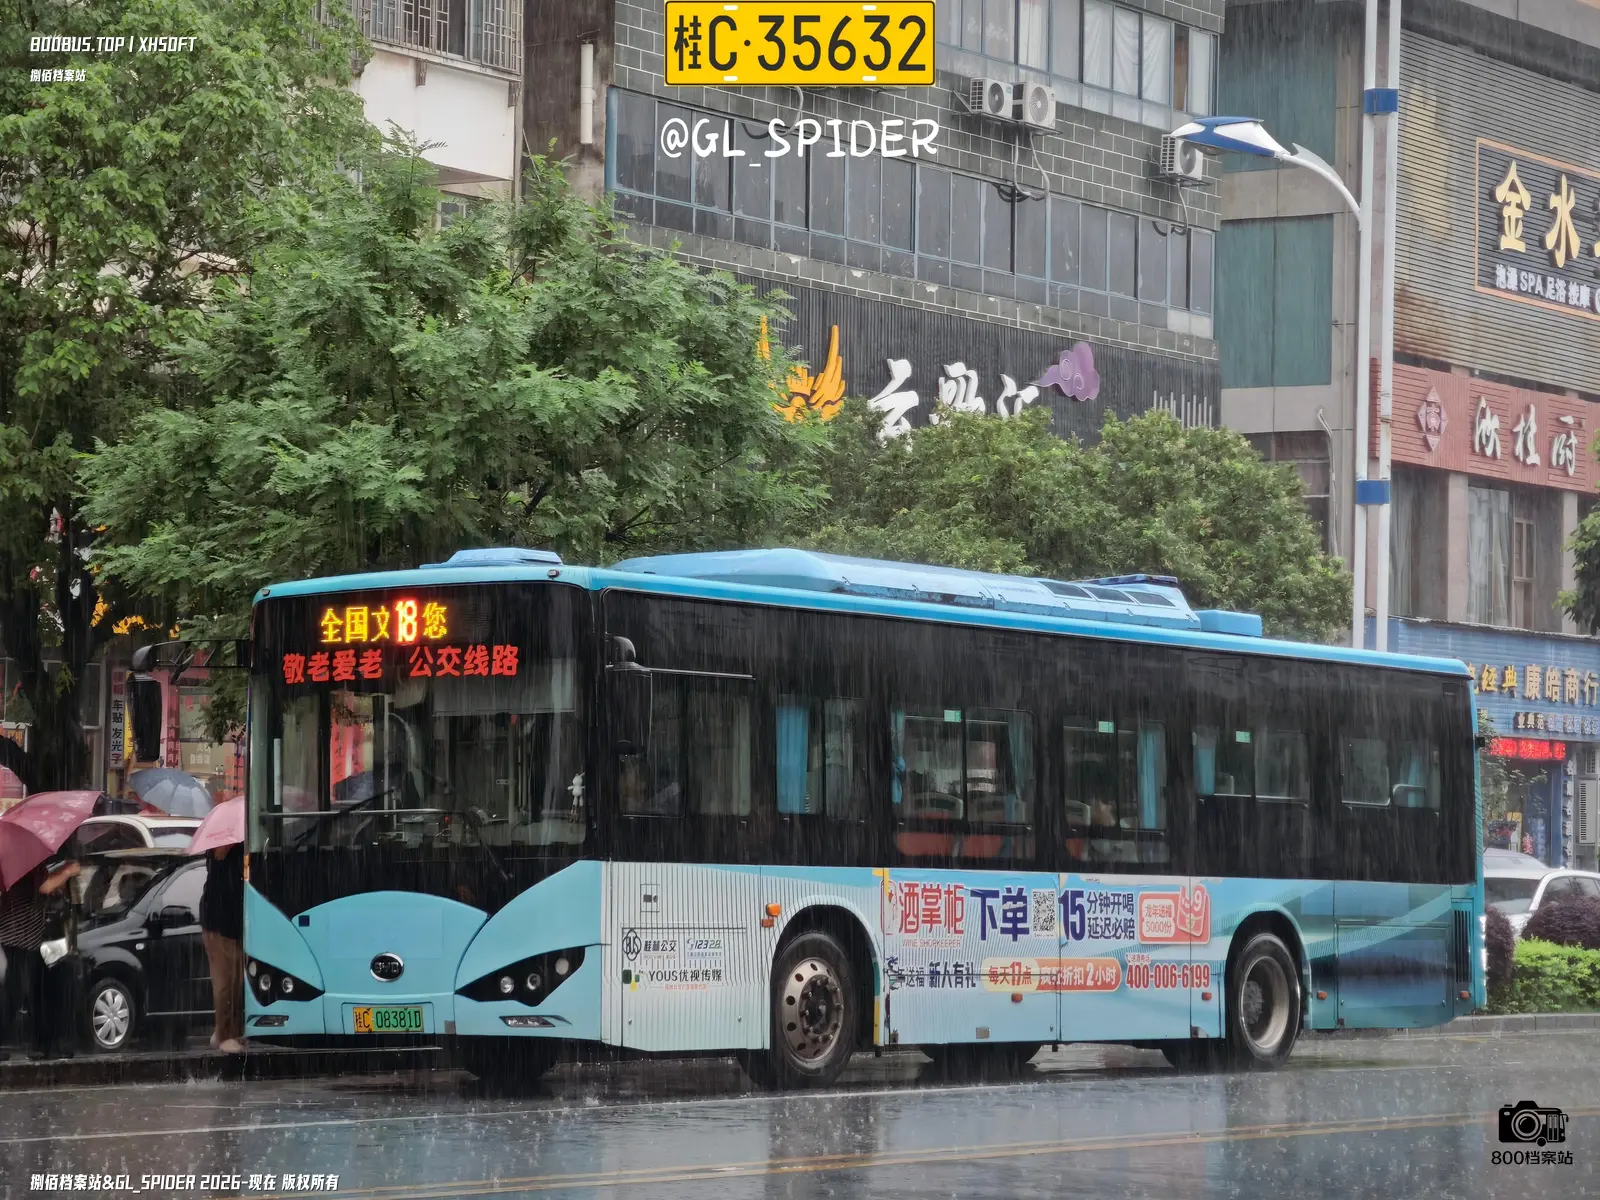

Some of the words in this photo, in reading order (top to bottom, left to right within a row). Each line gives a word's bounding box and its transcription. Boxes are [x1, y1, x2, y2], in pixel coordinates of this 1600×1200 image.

[1495, 160, 1600, 268] 金水
[1520, 271, 1545, 296] SPA
[282, 650, 384, 684] 敬老爱老
[408, 644, 519, 678] 公交线路
[898, 882, 965, 935] 酒掌柜
[969, 886, 1030, 942] 下单
[1058, 889, 1086, 941] 15
[1086, 891, 1135, 916] 分钟开喝
[1086, 916, 1136, 941] 延迟必赔
[928, 961, 977, 989] 新人有礼
[988, 961, 1033, 986] 每天17点
[1126, 964, 1211, 990] 400-006-6199
